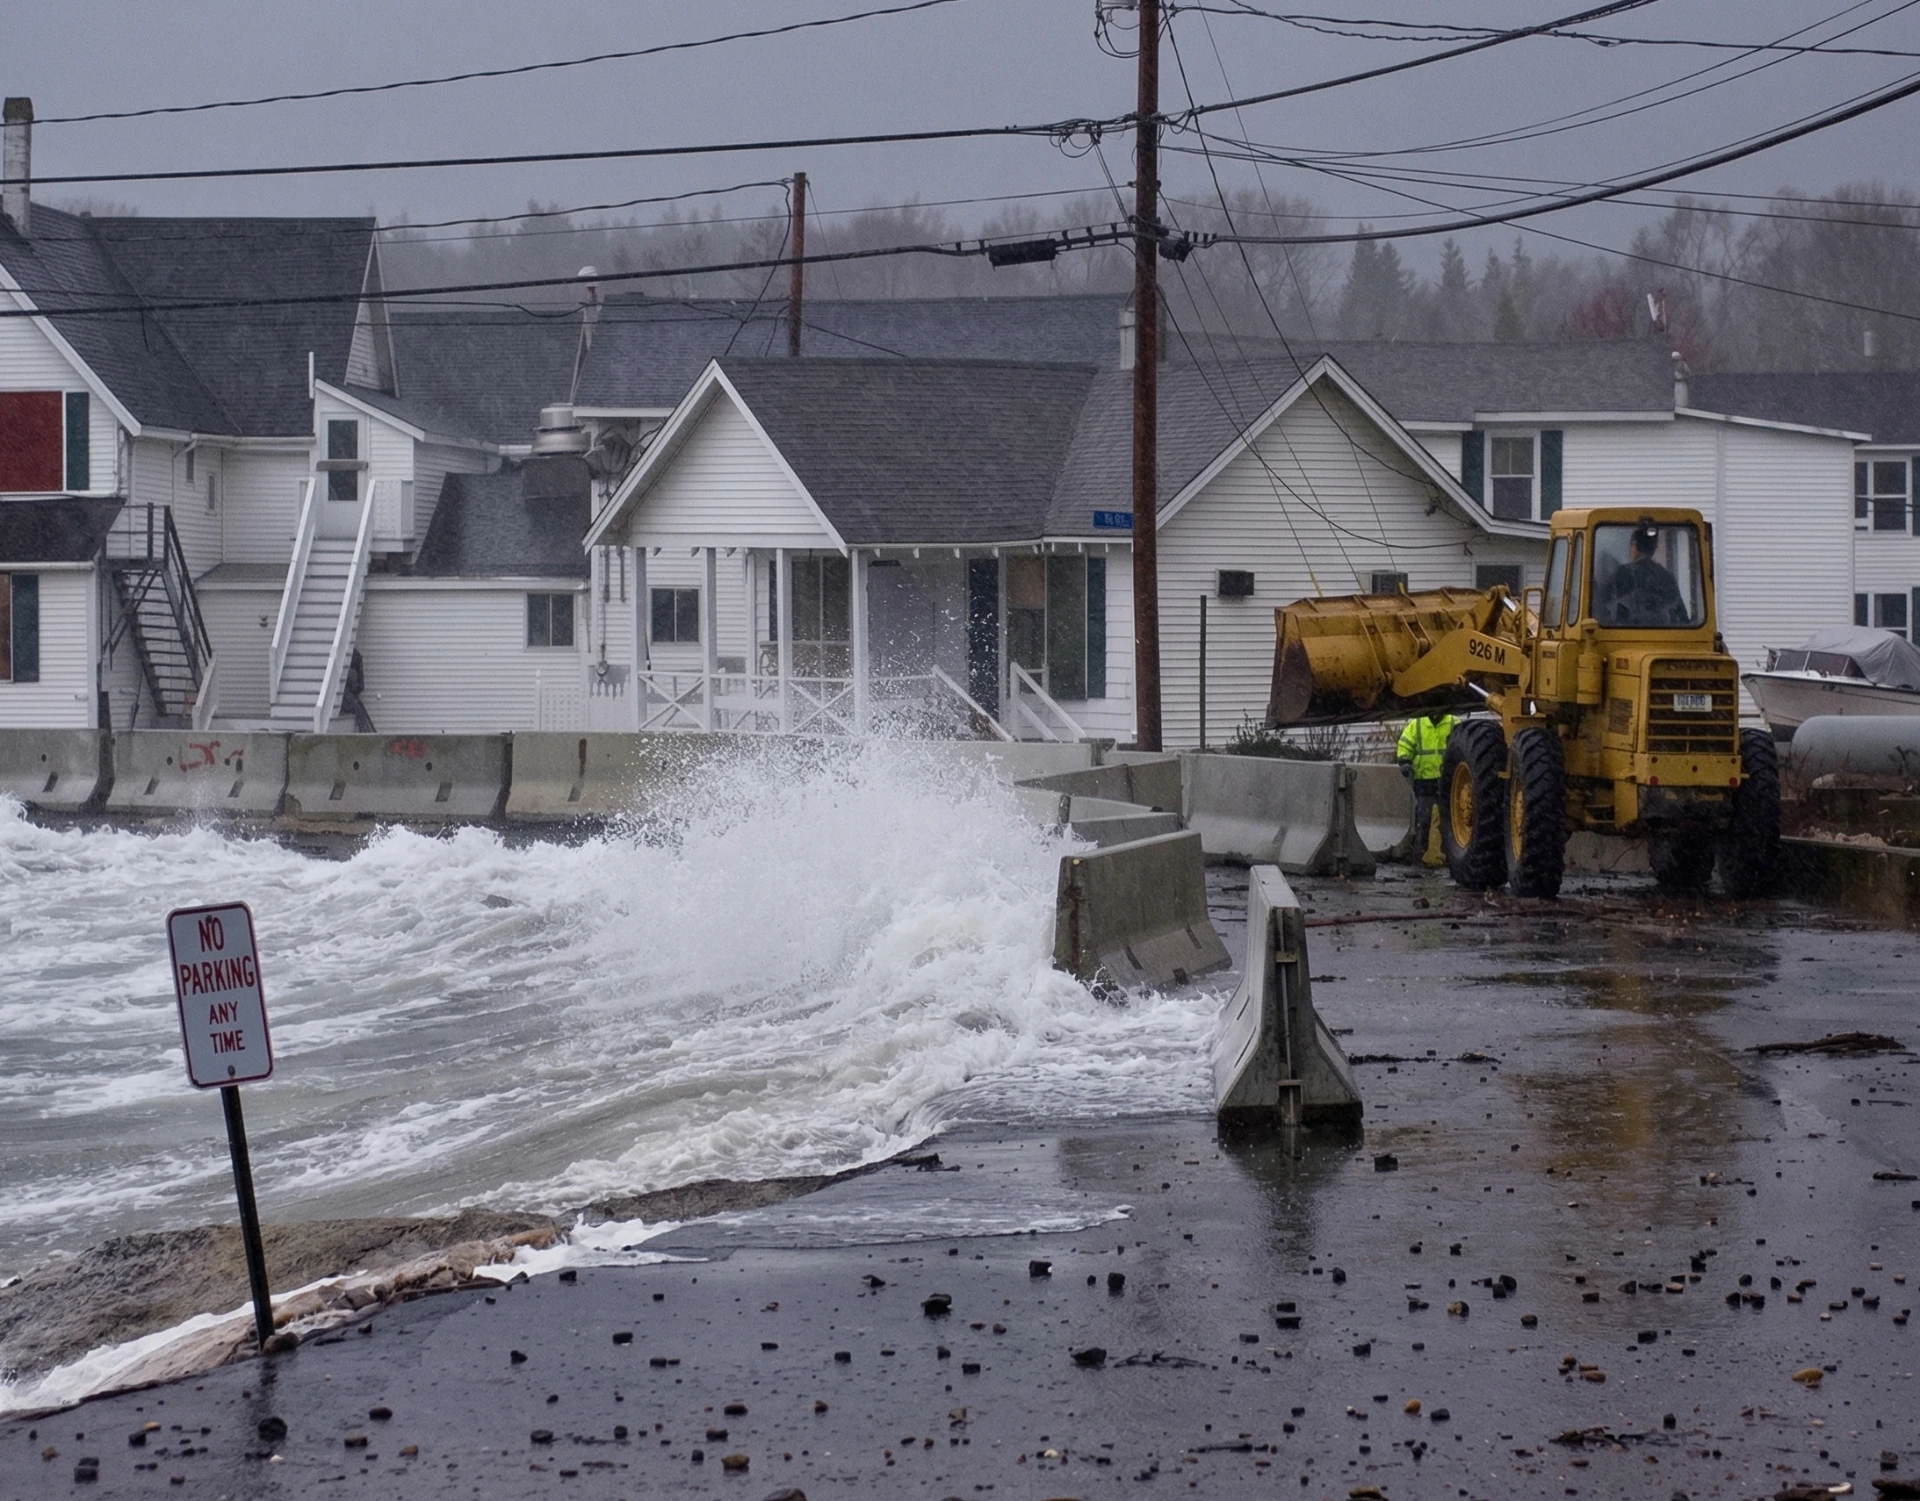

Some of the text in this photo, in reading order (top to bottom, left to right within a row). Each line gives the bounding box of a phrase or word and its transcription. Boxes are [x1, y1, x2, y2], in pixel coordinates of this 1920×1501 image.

[1469, 639, 1506, 666] 926 M
[198, 917, 224, 952] NO
[180, 955, 255, 996] PARKING
[209, 1001, 239, 1025] ANY
[209, 1029, 246, 1054] TIME
